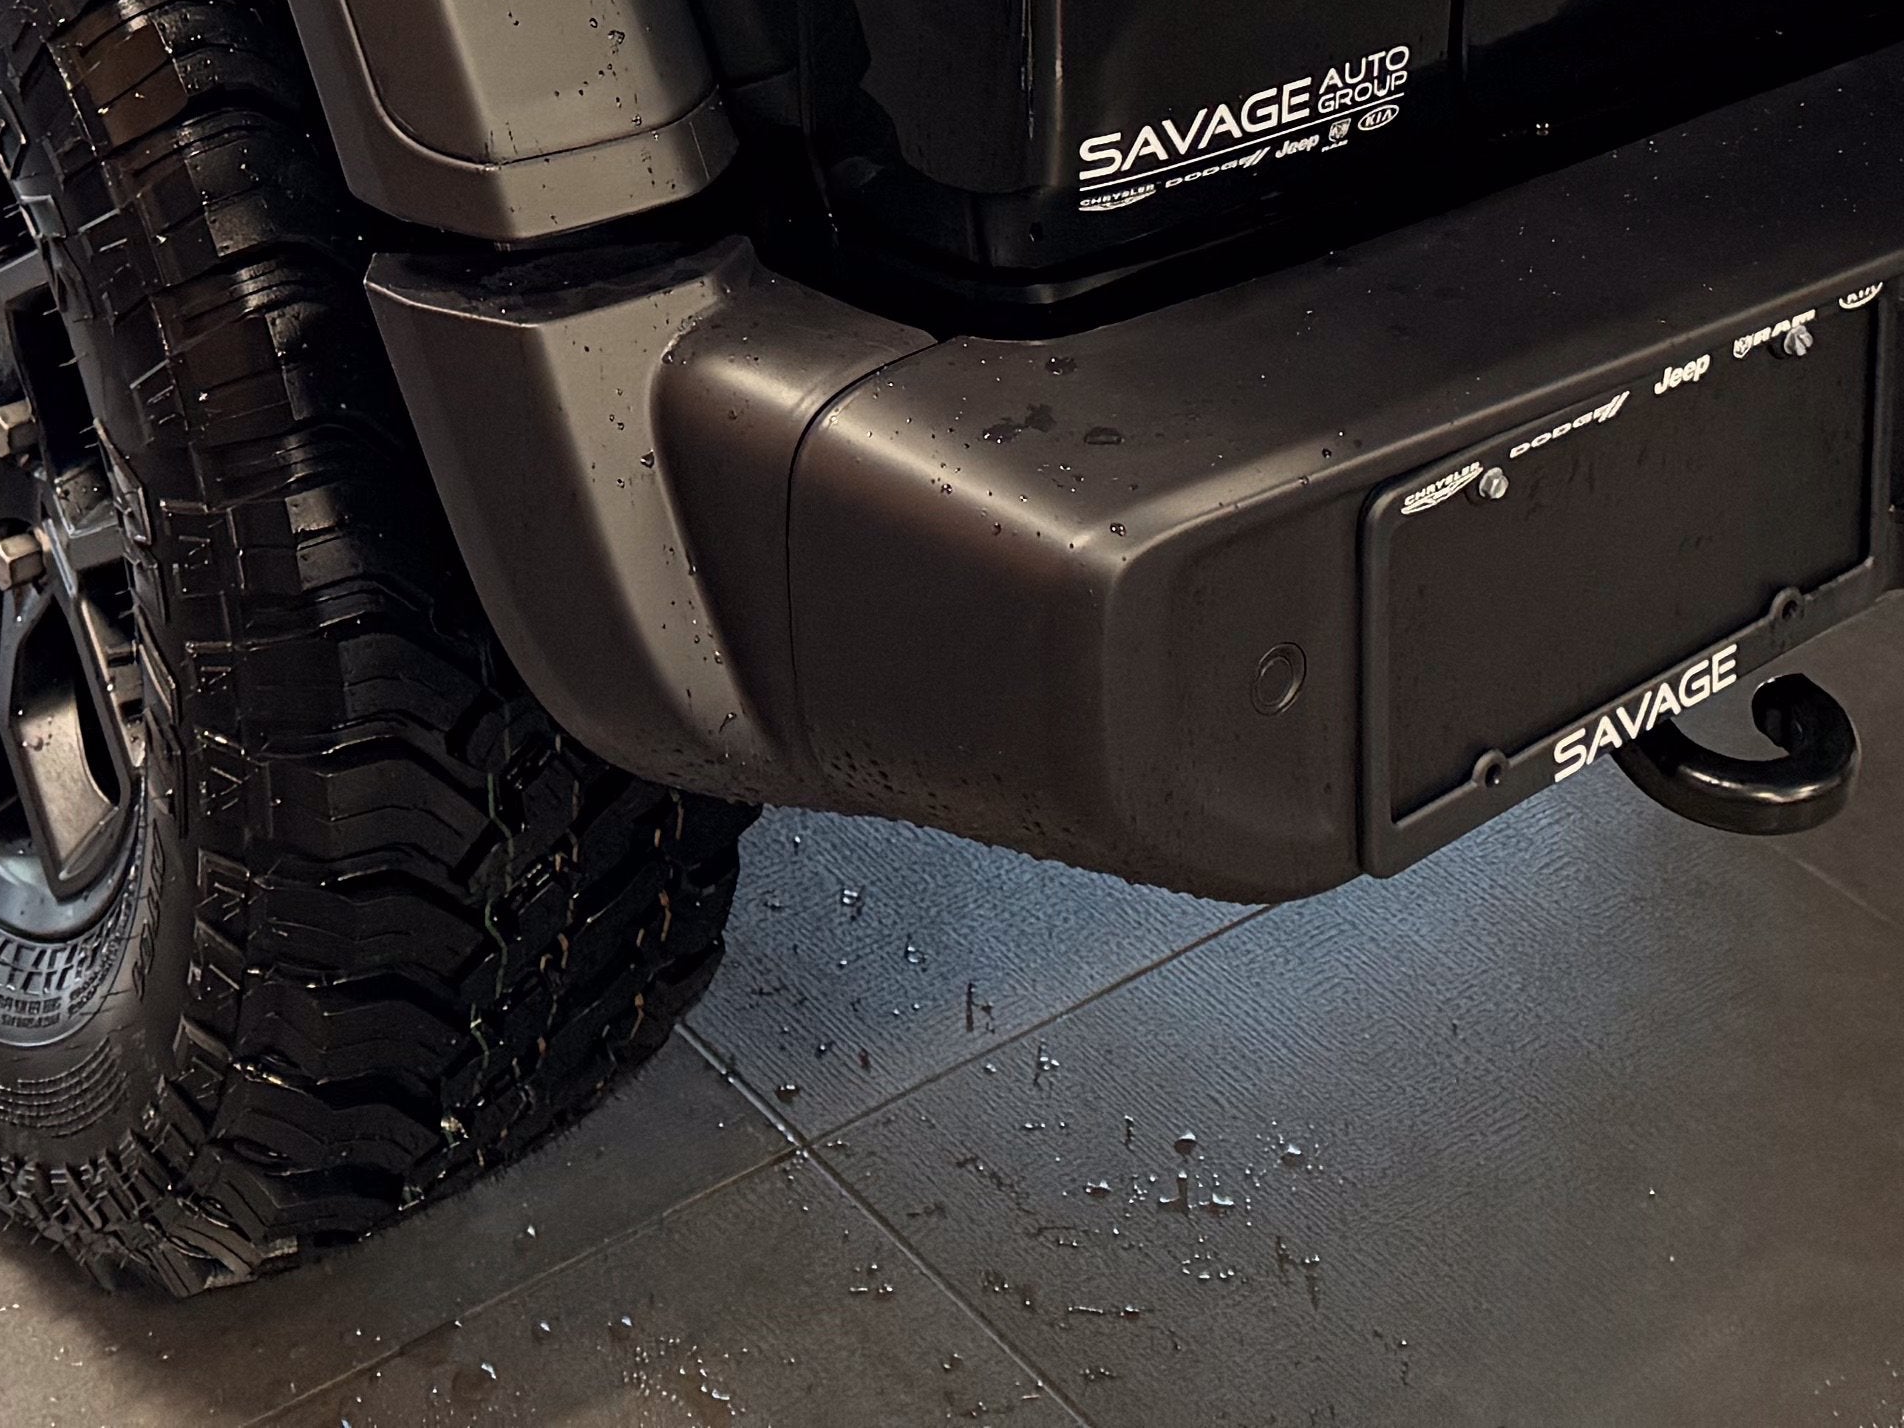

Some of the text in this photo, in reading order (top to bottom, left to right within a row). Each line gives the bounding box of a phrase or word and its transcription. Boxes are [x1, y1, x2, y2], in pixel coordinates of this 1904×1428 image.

[1079, 45, 1410, 180] SAVAGE AUTO
[1080, 182, 1155, 207] CHRYSLER
[1275, 134, 1320, 159] Jeep
[1364, 107, 1395, 128] KIA
[1317, 70, 1408, 114] GROUP
[1404, 461, 1481, 506] CHRYSLER
[1654, 353, 1712, 395] Jeep
[1553, 643, 1738, 783] SAVAGE
